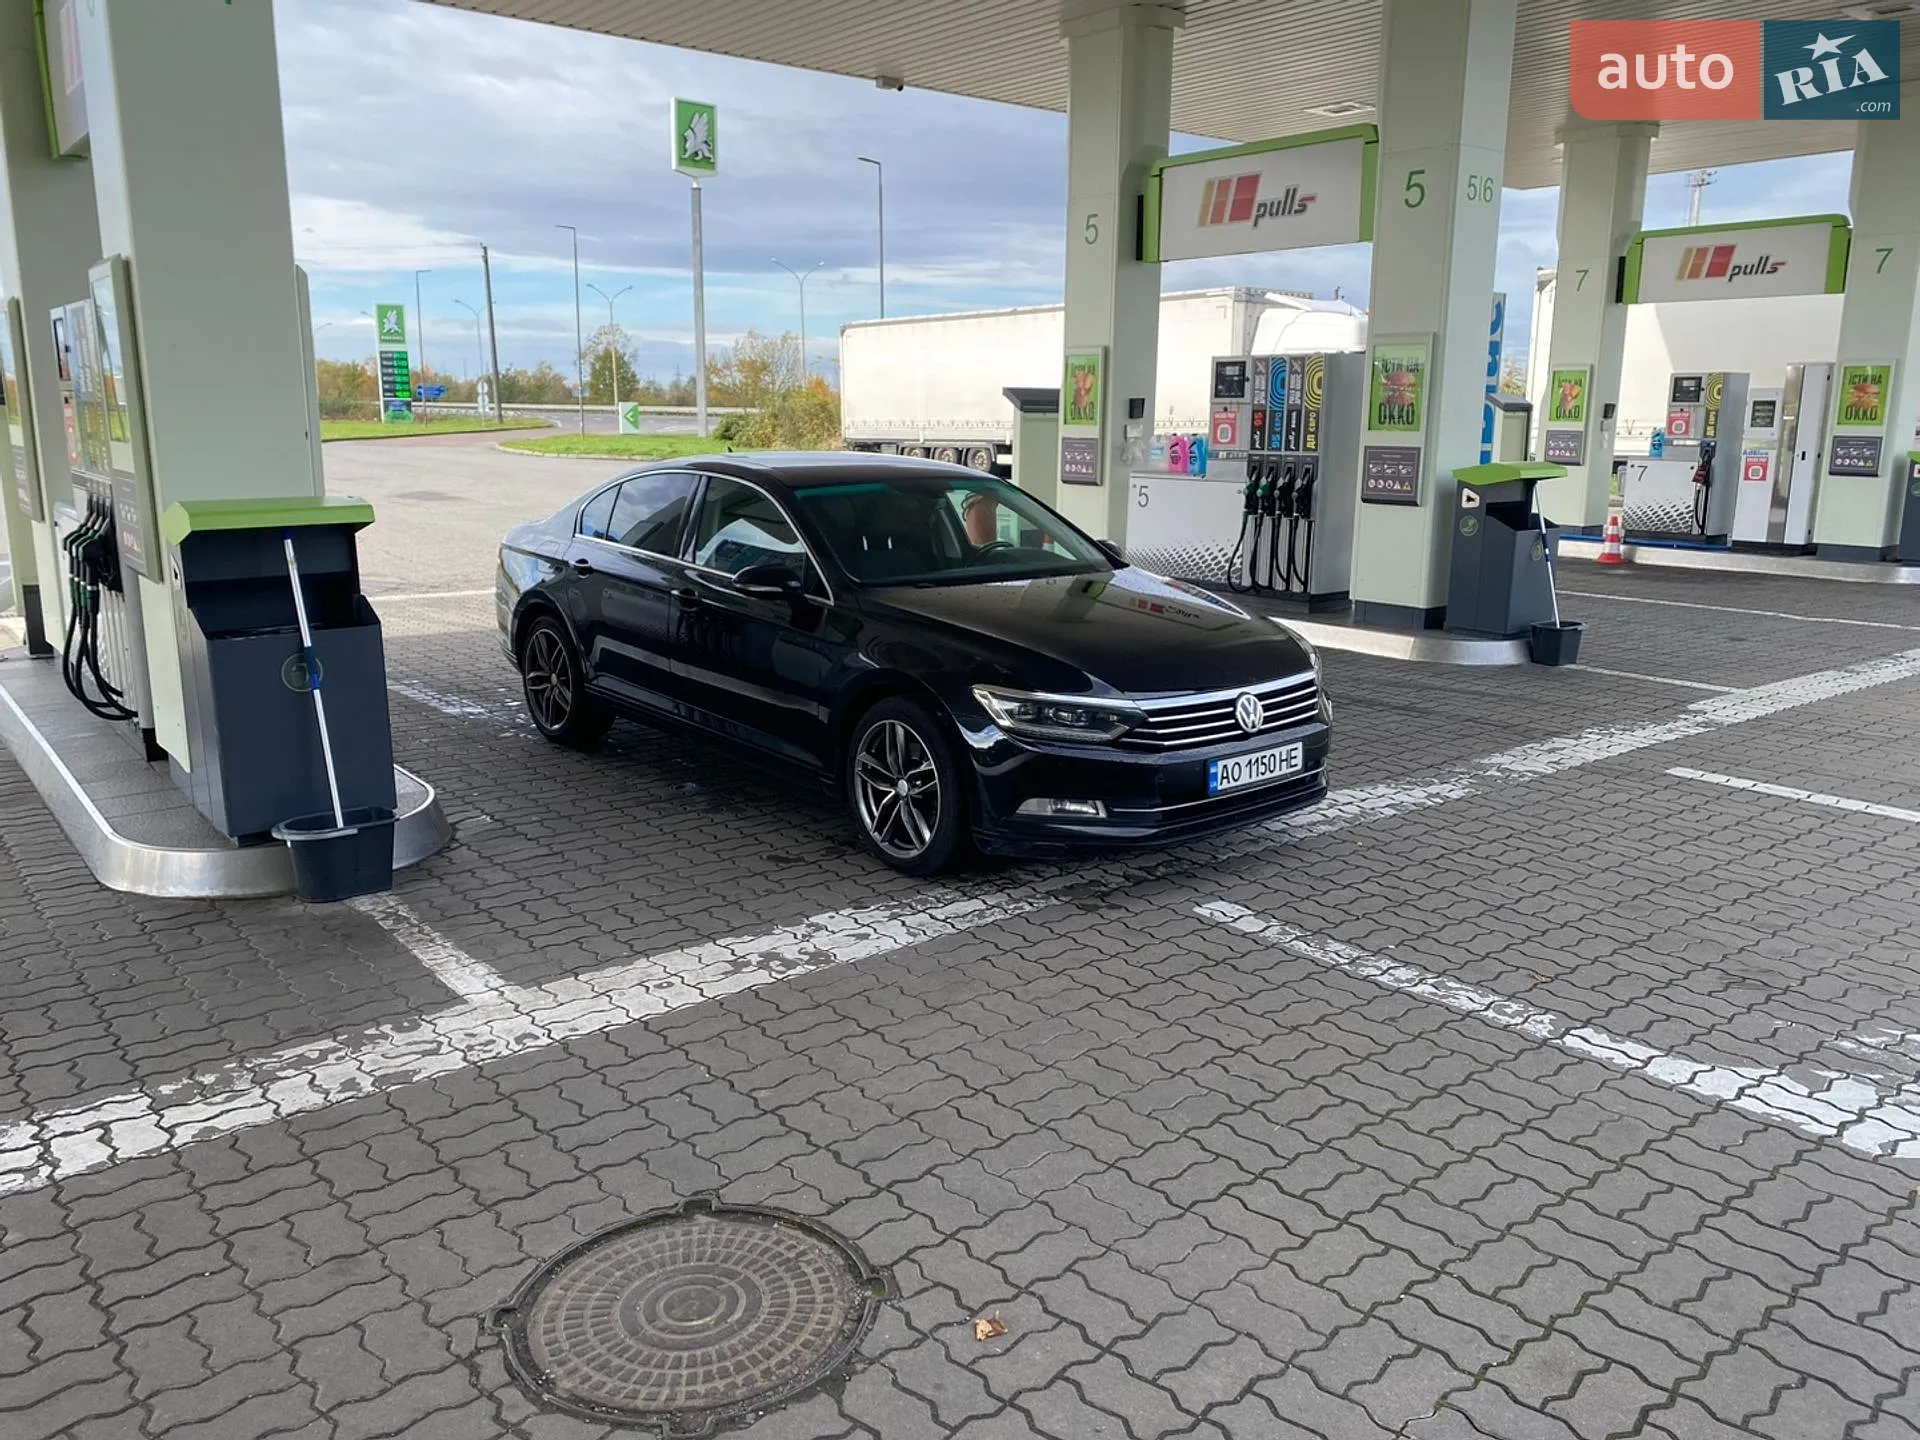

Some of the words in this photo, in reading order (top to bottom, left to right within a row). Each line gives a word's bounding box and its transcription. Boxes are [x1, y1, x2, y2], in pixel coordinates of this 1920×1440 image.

[1403, 168, 1426, 209] 5
[1252, 184, 1317, 229] pulls
[1084, 213, 1100, 246] 5
[1727, 254, 1787, 283] pulls
[1874, 247, 1894, 275] 7
[1575, 269, 1590, 292] 7
[1636, 465, 1648, 482] 7
[1137, 485, 1149, 508] 5
[1219, 761, 1242, 786] AO
[1245, 753, 1276, 780] 1150
[1279, 747, 1299, 772] HE
